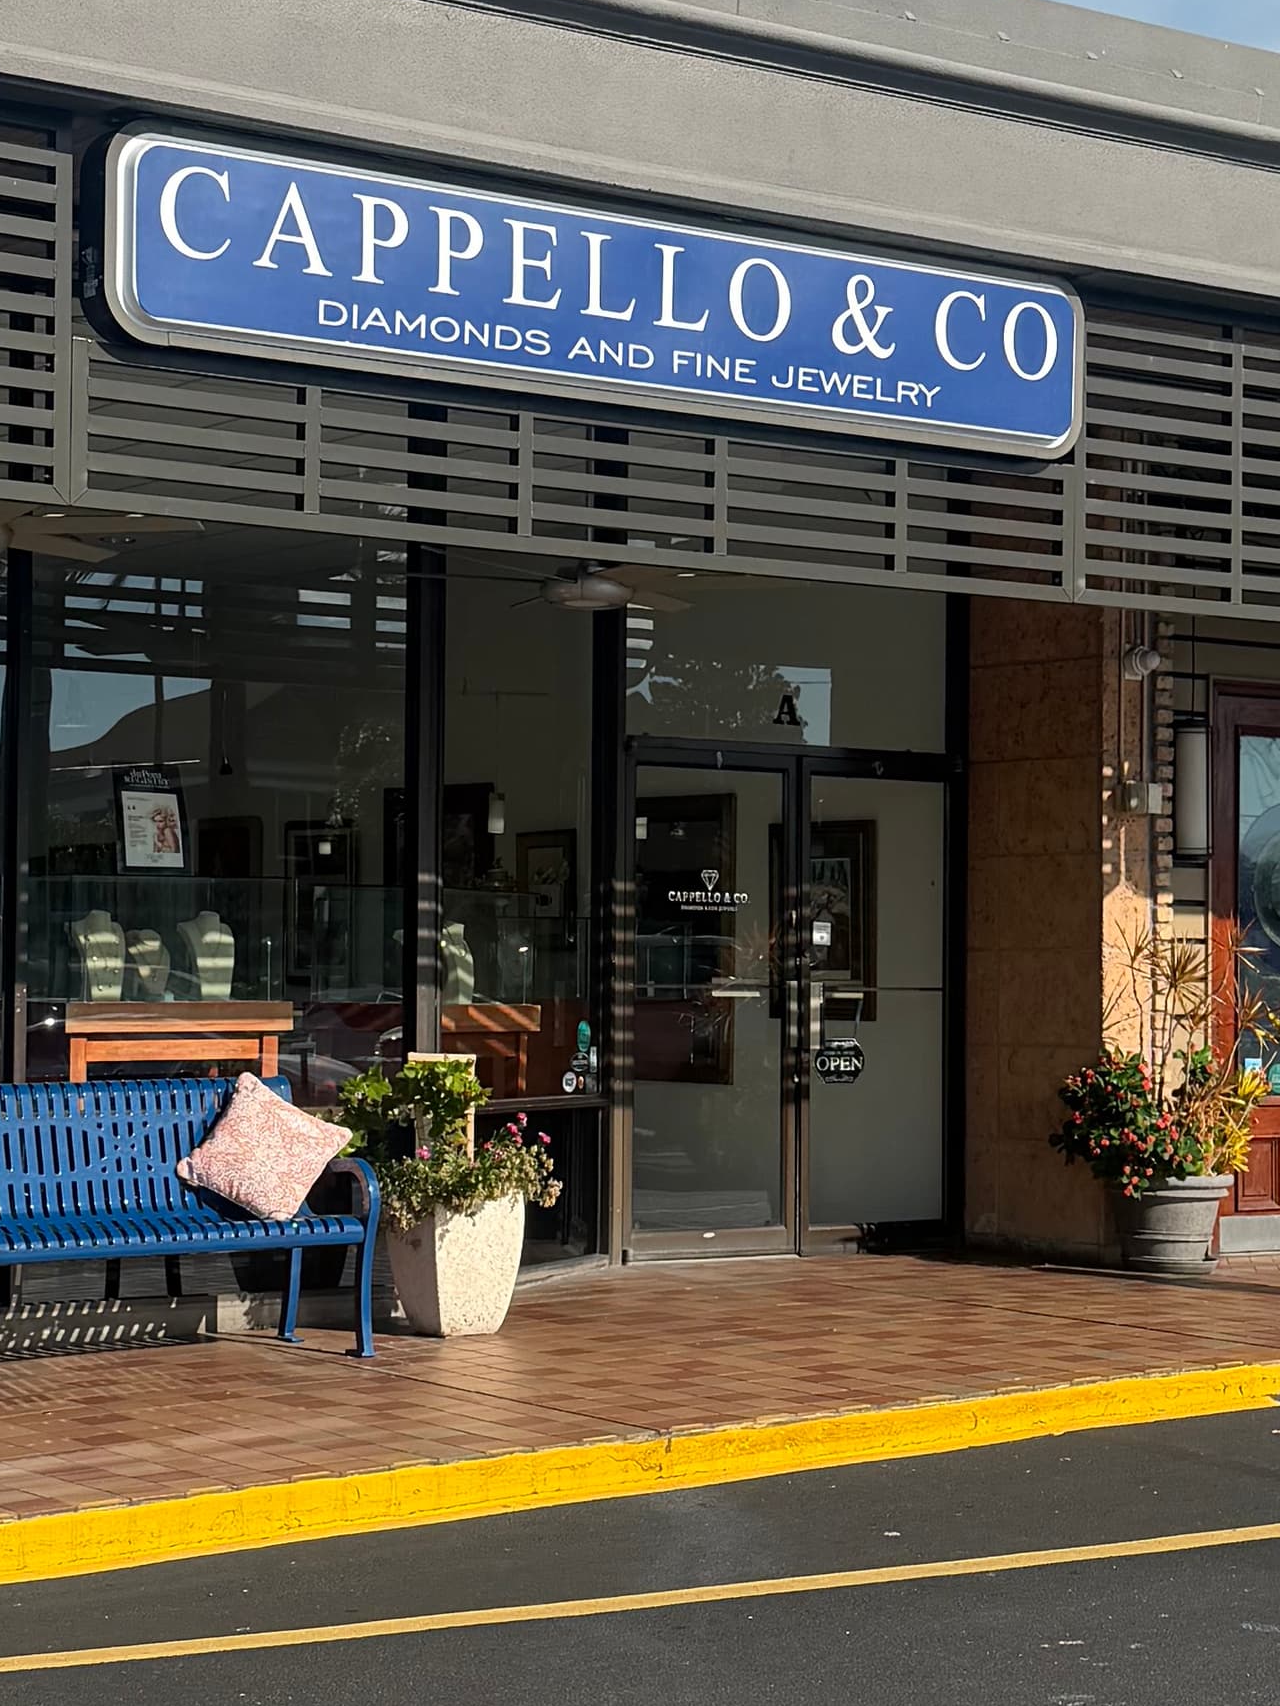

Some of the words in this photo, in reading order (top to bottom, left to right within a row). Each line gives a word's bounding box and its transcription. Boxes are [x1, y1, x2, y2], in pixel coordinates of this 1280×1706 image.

[159, 165, 791, 343] CAPPELLO
[831, 273, 896, 360] &
[934, 290, 1058, 381] CO
[318, 299, 552, 356] DIAMONDS
[567, 336, 655, 370] AND
[672, 349, 758, 385] FINE
[771, 365, 942, 409] JEWELRY
[772, 694, 801, 727] A
[668, 890, 721, 904] CAPPELLO
[816, 1056, 864, 1071] OPEN
